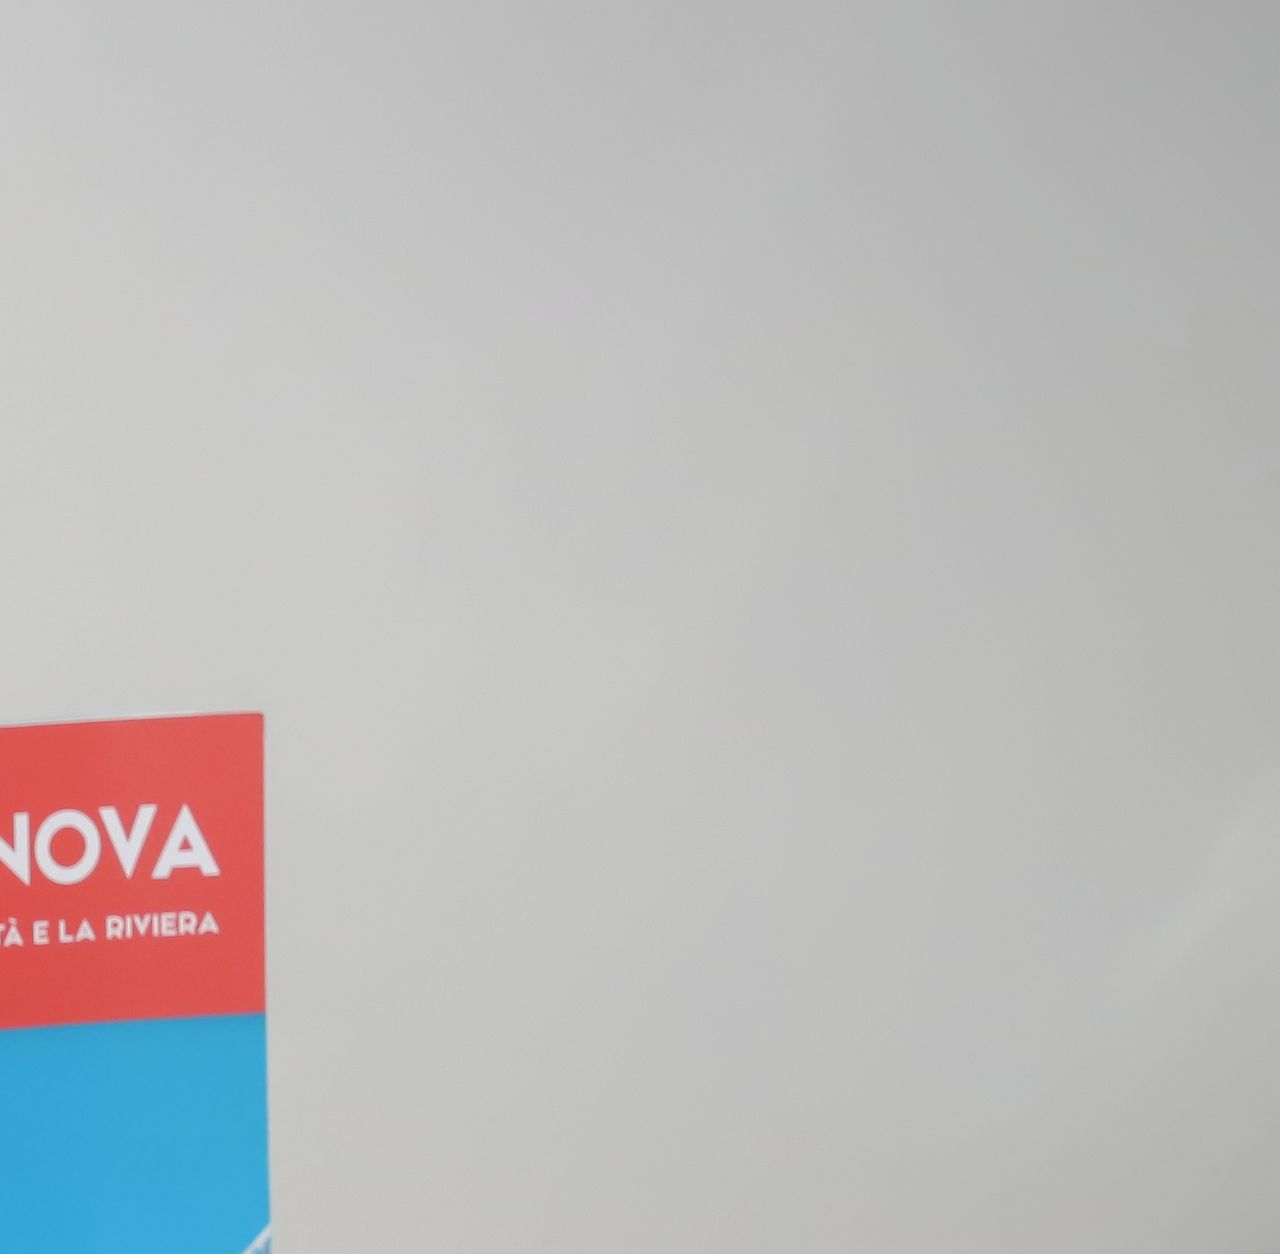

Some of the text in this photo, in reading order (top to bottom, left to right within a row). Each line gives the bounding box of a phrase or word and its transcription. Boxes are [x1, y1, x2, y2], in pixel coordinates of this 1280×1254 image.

[32, 920, 50, 945] E
[58, 918, 96, 944] LA
[105, 911, 220, 940] RIVIERA
